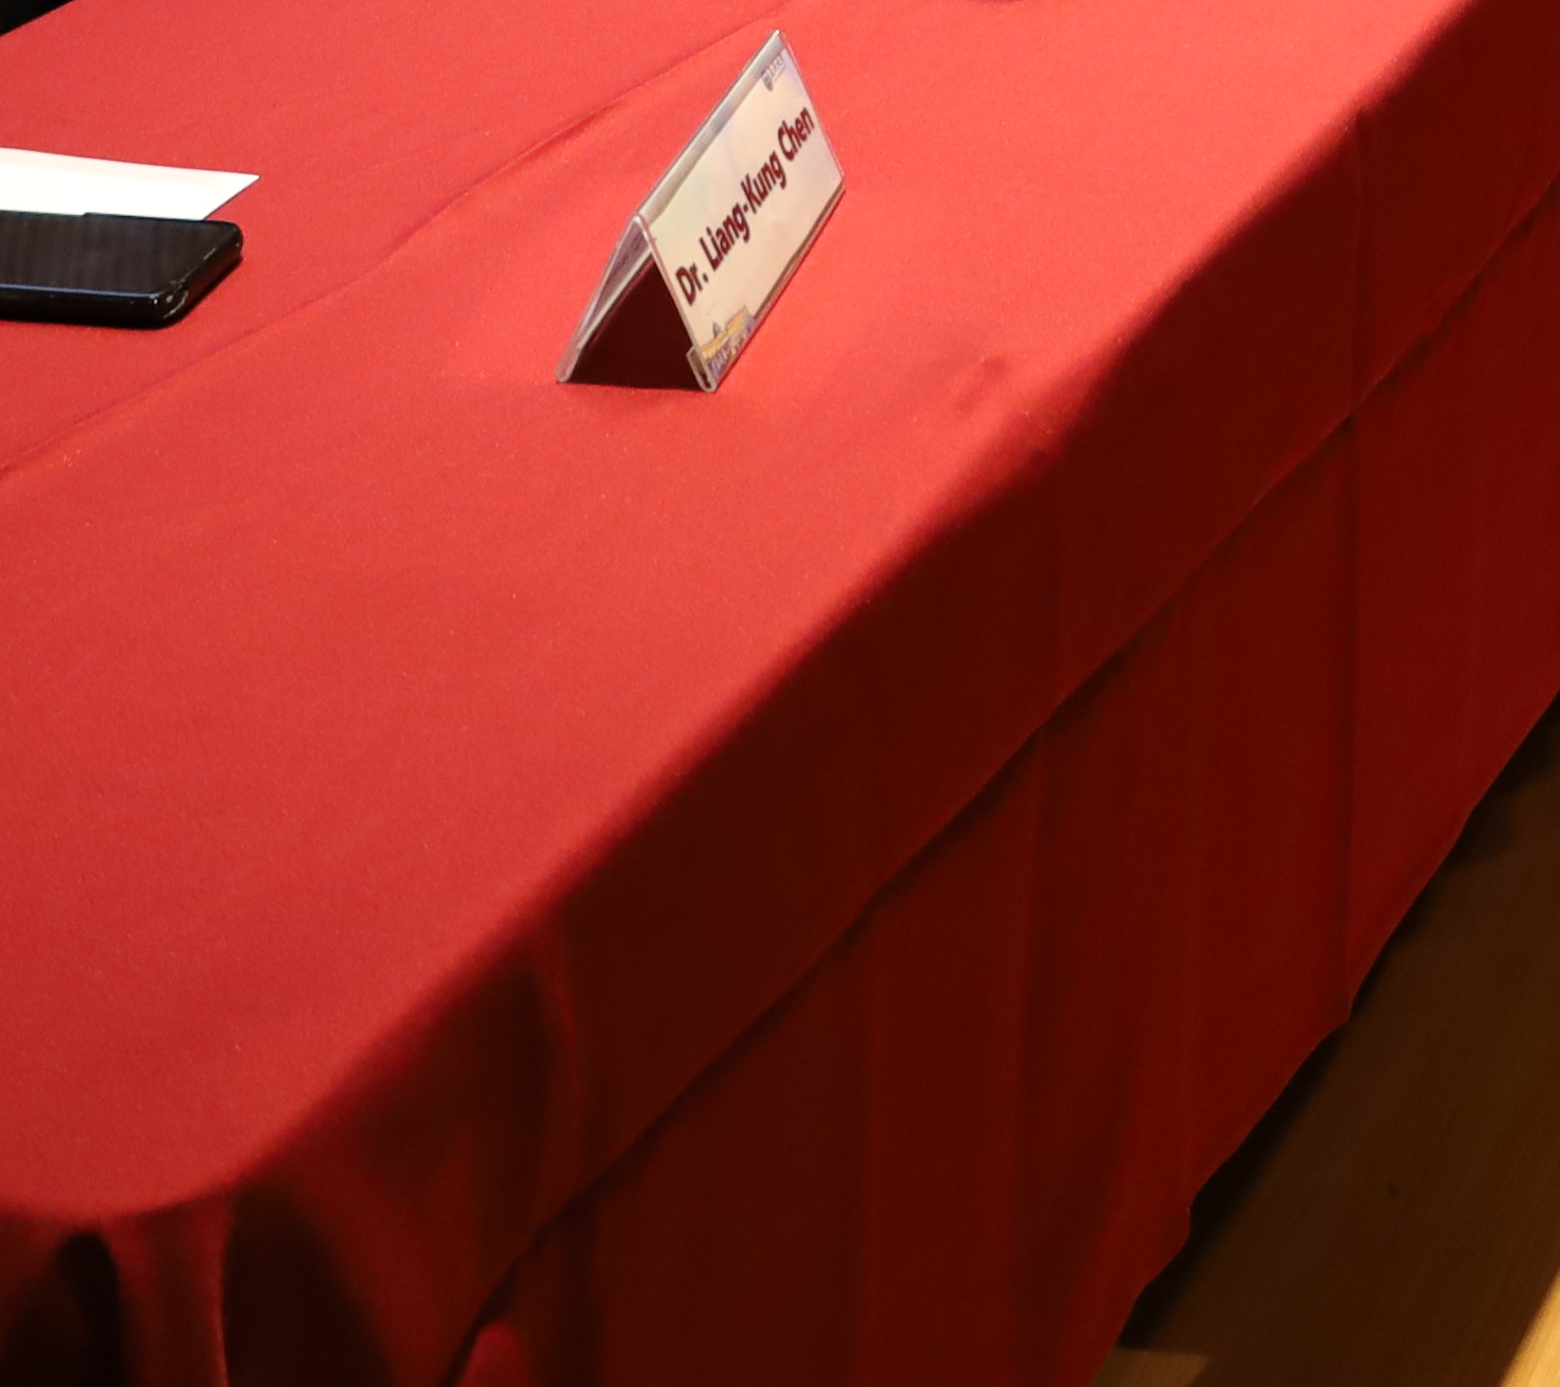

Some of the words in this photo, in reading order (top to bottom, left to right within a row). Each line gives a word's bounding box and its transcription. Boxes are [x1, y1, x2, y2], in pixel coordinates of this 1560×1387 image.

[676, 261, 708, 306] Dr.
[699, 149, 786, 271] Liang-Kung
[777, 107, 815, 162] Chen
